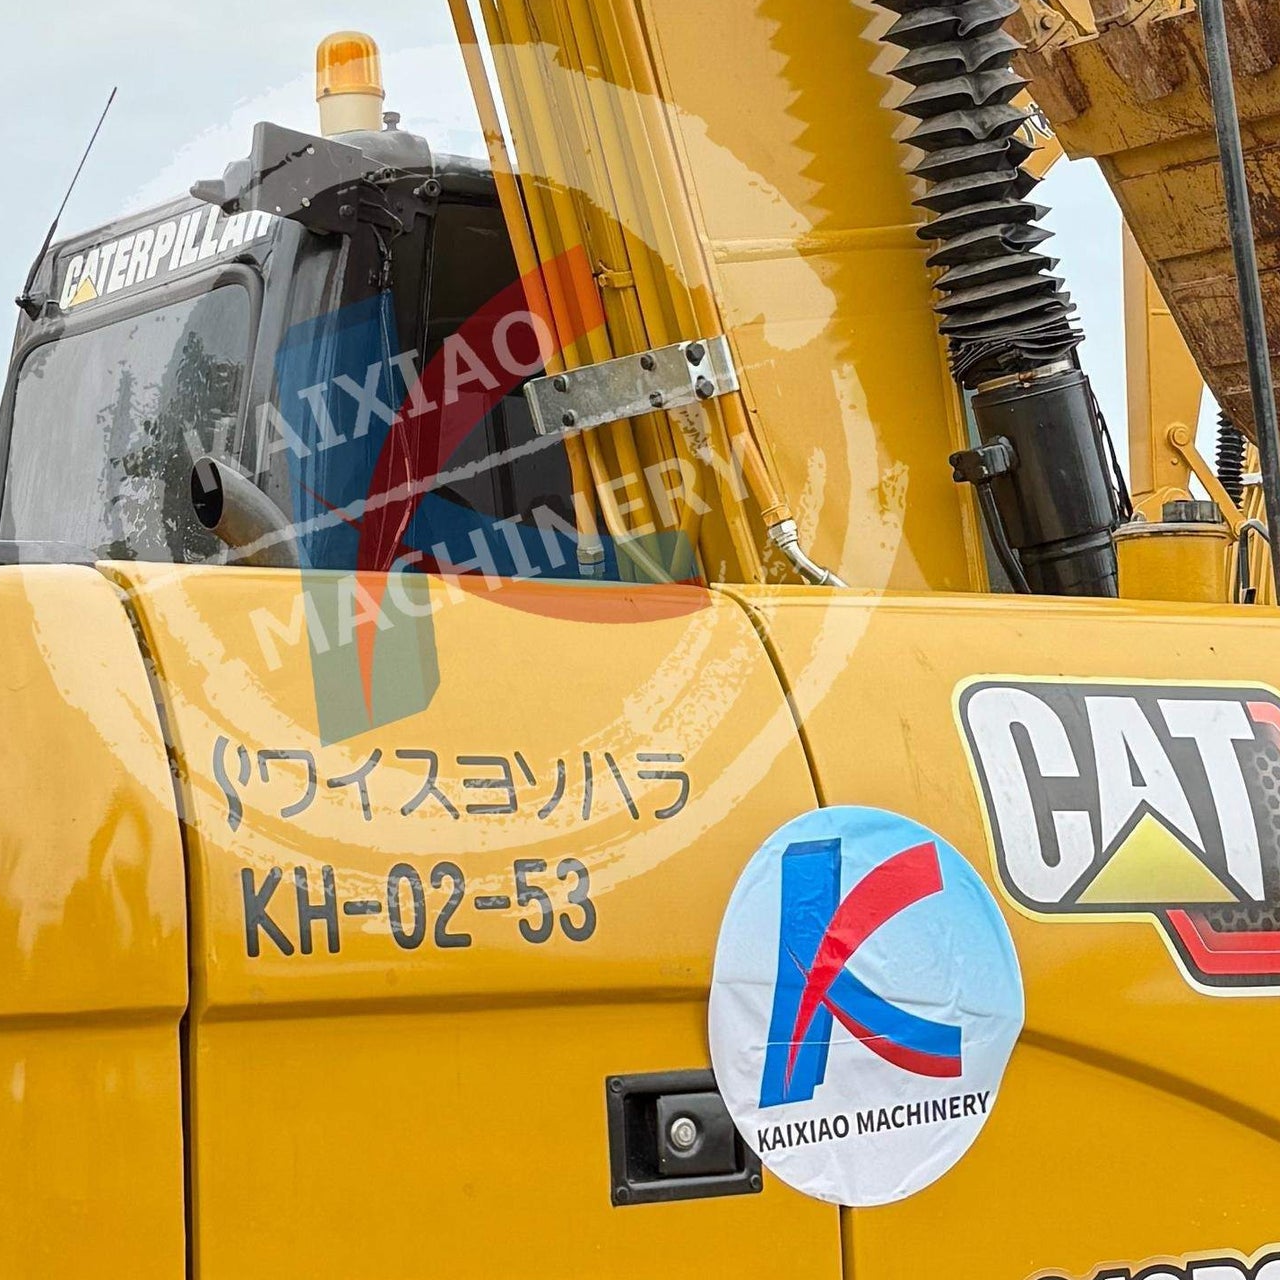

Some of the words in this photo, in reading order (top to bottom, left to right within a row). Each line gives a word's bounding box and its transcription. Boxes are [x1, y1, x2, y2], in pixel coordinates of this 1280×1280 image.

[967, 687, 1266, 903] CAT
[240, 857, 597, 958] KH-02-53
[757, 1113, 851, 1153] KAIXIAO
[856, 1090, 992, 1136] MACHINERY
